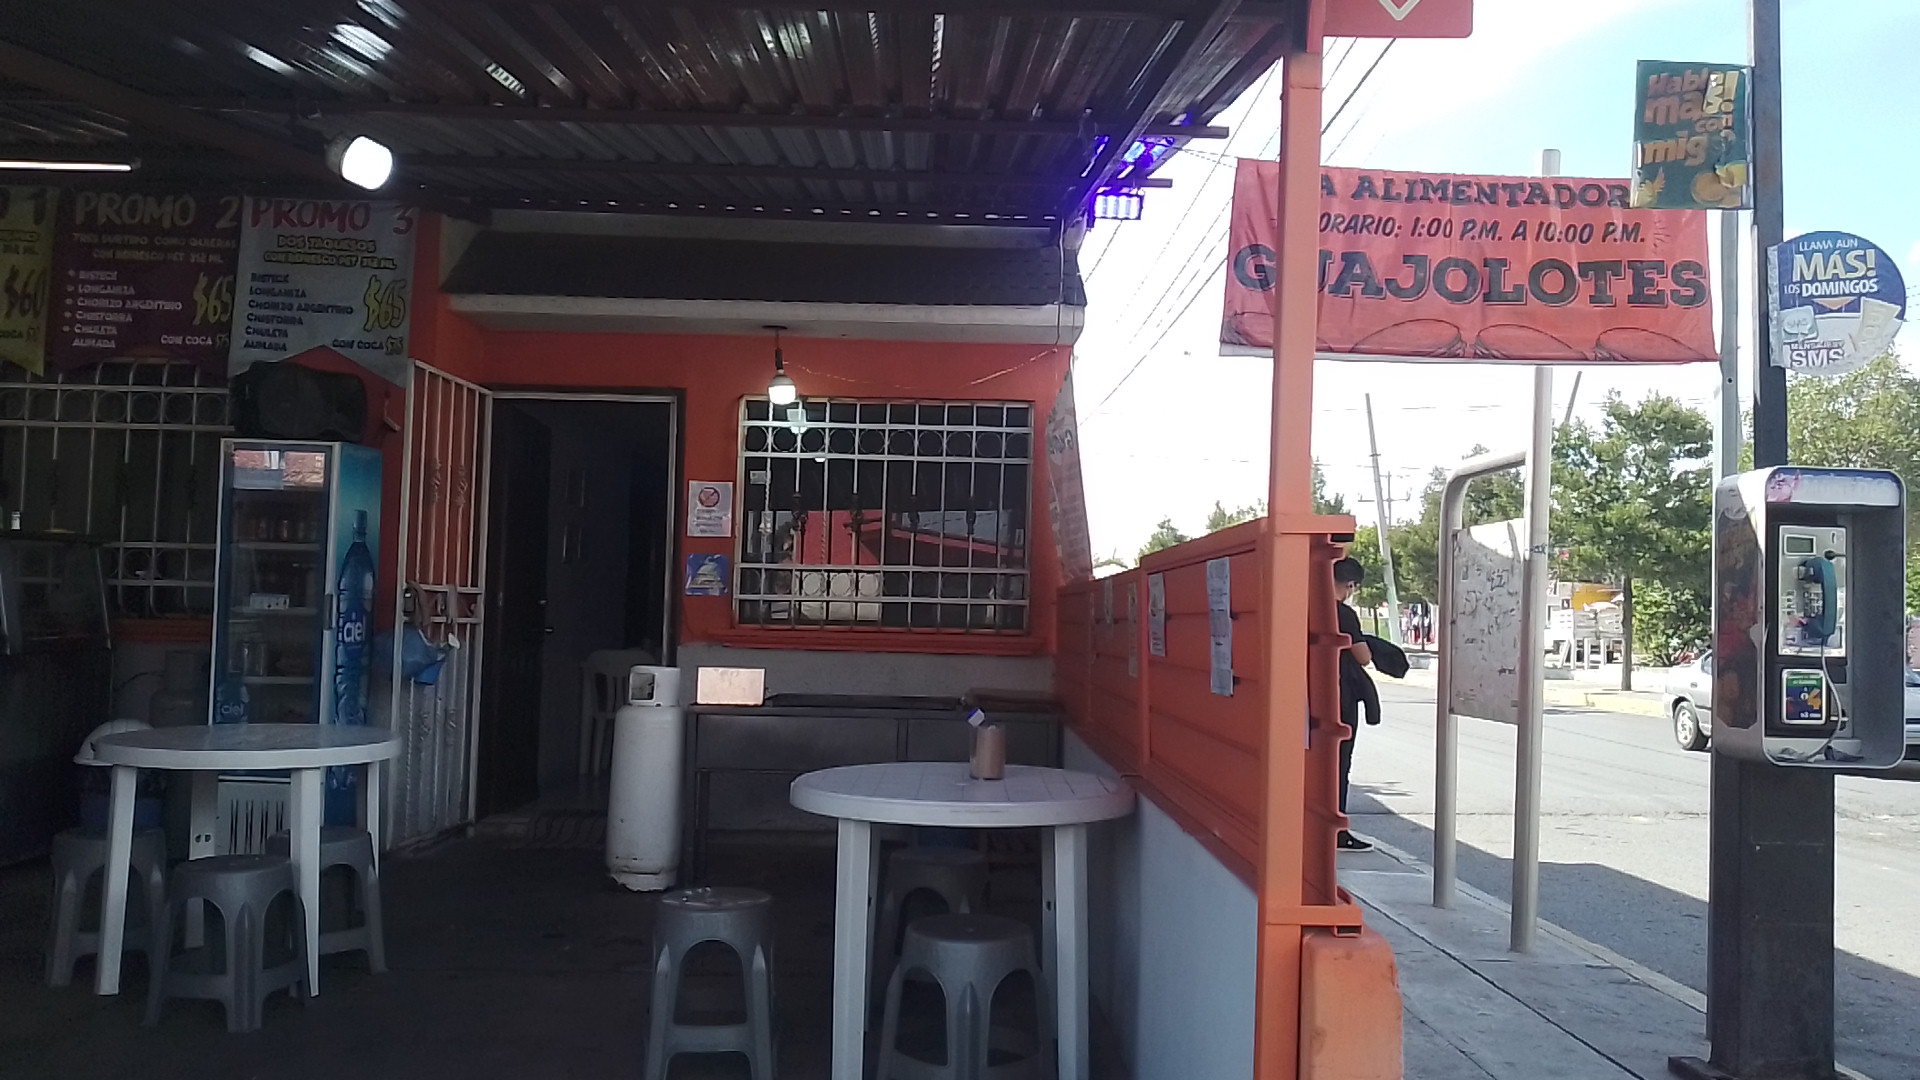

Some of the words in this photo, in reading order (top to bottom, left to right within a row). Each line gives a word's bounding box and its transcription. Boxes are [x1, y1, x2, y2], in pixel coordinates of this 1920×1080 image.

[74, 192, 197, 229] PROMO
[215, 195, 241, 230] 2
[251, 198, 371, 233] PROMO
[393, 205, 415, 234] 3
[1319, 211, 1403, 240] ORARIO:
[1409, 215, 1453, 241] 1:00
[1459, 217, 1504, 243] P.M.
[1511, 219, 1528, 242] A
[1535, 221, 1594, 245] 10:00
[1601, 222, 1646, 244] P.M.
[277, 234, 305, 249] DOS
[1799, 240, 1833, 251] LLAMA
[1793, 249, 1877, 282] MÁS!
[78, 284, 136, 296] LONGANIZA
[249, 286, 306, 298] LONGANIZA
[1784, 284, 1800, 294] LOS
[1801, 278, 1879, 297] DOMINGOS
[77, 296, 123, 309] CHORIZO
[125, 299, 183, 311] ARGENTINO
[192, 271, 236, 326] $65
[363, 274, 407, 332] $65
[248, 300, 293, 312] CHORIZO
[296, 302, 354, 314] ARGENTINO
[247, 313, 304, 325] CHISTORRA
[245, 325, 288, 338] CHULETA
[160, 334, 183, 345] CON
[185, 335, 213, 346] COCA
[332, 338, 355, 349] CON
[357, 340, 384, 350] COCA
